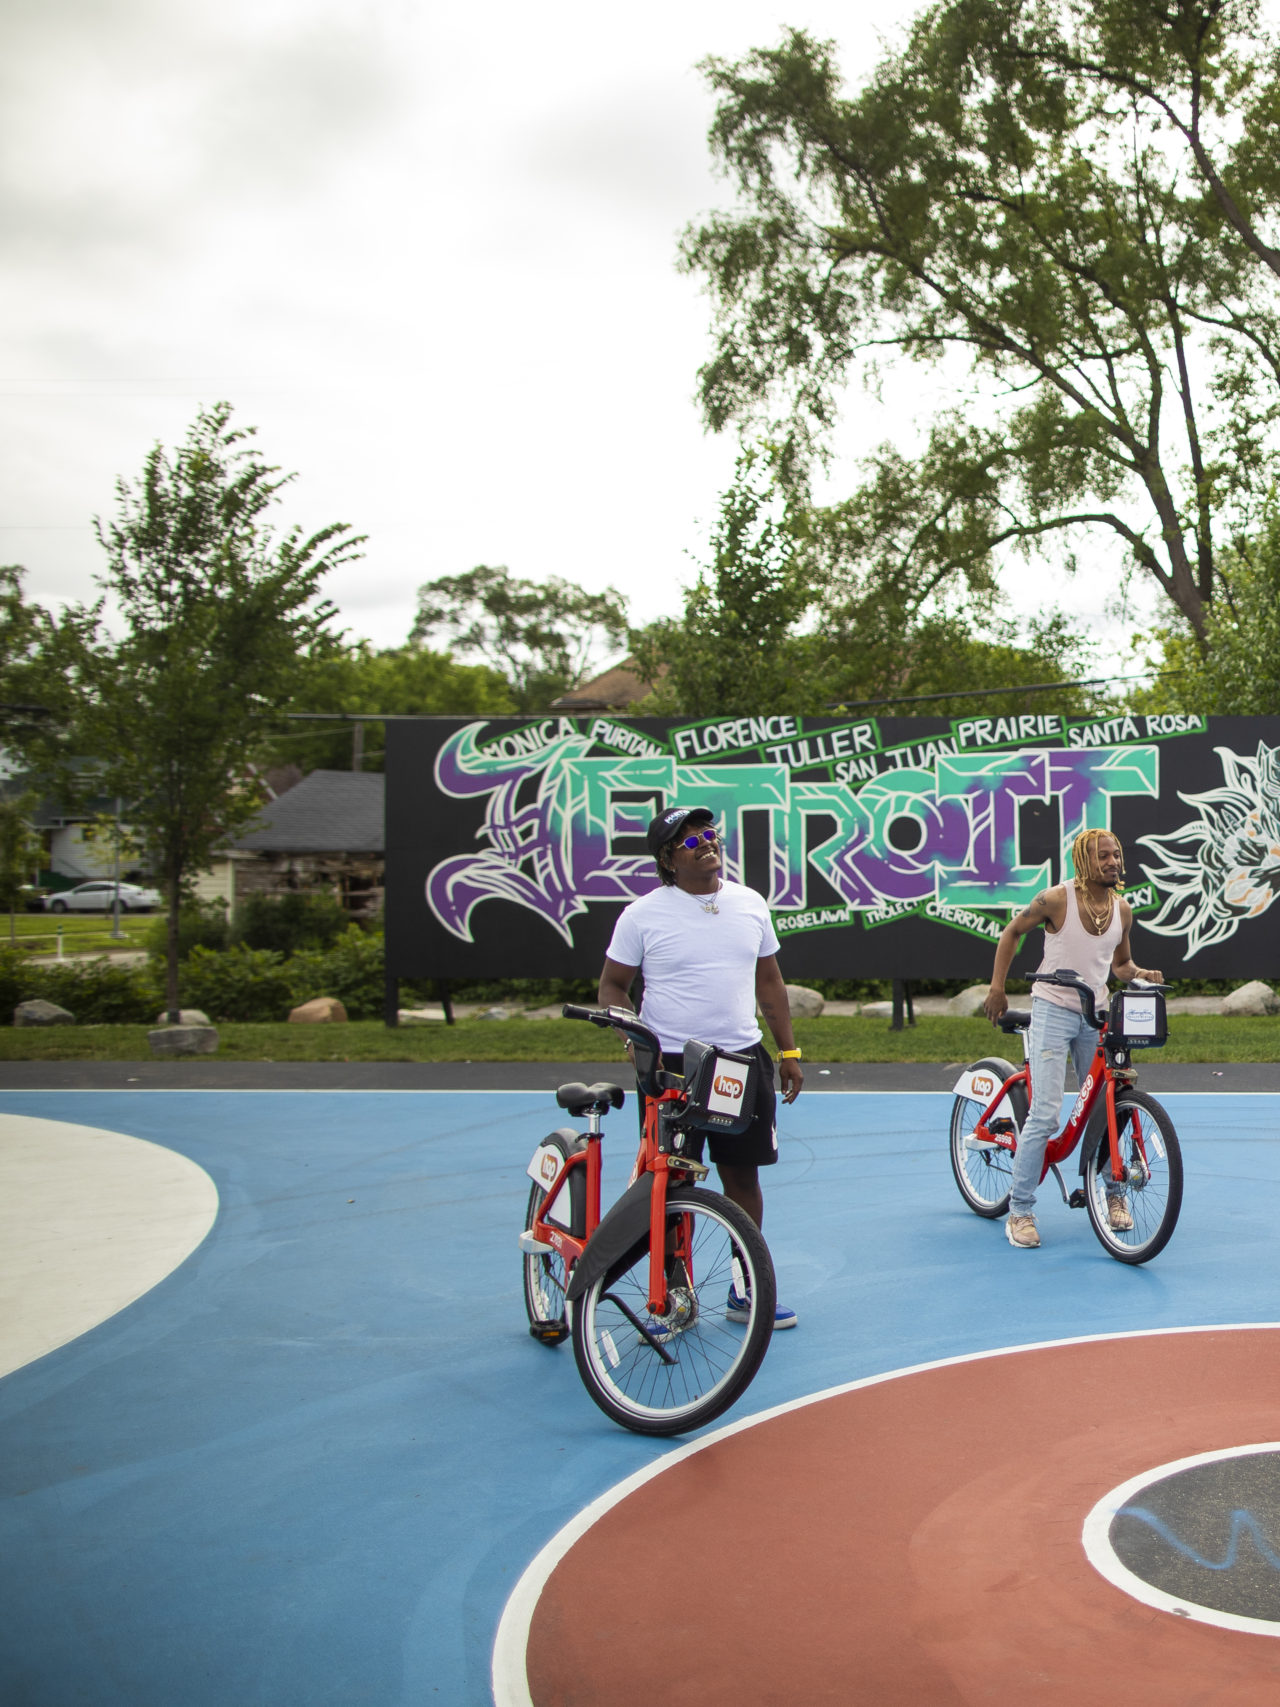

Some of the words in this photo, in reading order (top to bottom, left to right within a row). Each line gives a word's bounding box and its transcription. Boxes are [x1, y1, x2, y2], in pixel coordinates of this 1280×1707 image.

[482, 716, 576, 760] MONICA
[589, 718, 663, 759] PURITAN
[674, 715, 798, 760] FLORENCE
[765, 723, 877, 769] TULLER
[958, 714, 1062, 748] PRAIRIE
[1068, 716, 1140, 749] SANTA
[1145, 714, 1203, 736] ROSA
[834, 755, 878, 784] SAN
[884, 736, 961, 771] JUAN
[775, 906, 851, 932] ROSELAWN
[717, 1075, 741, 1099] hap
